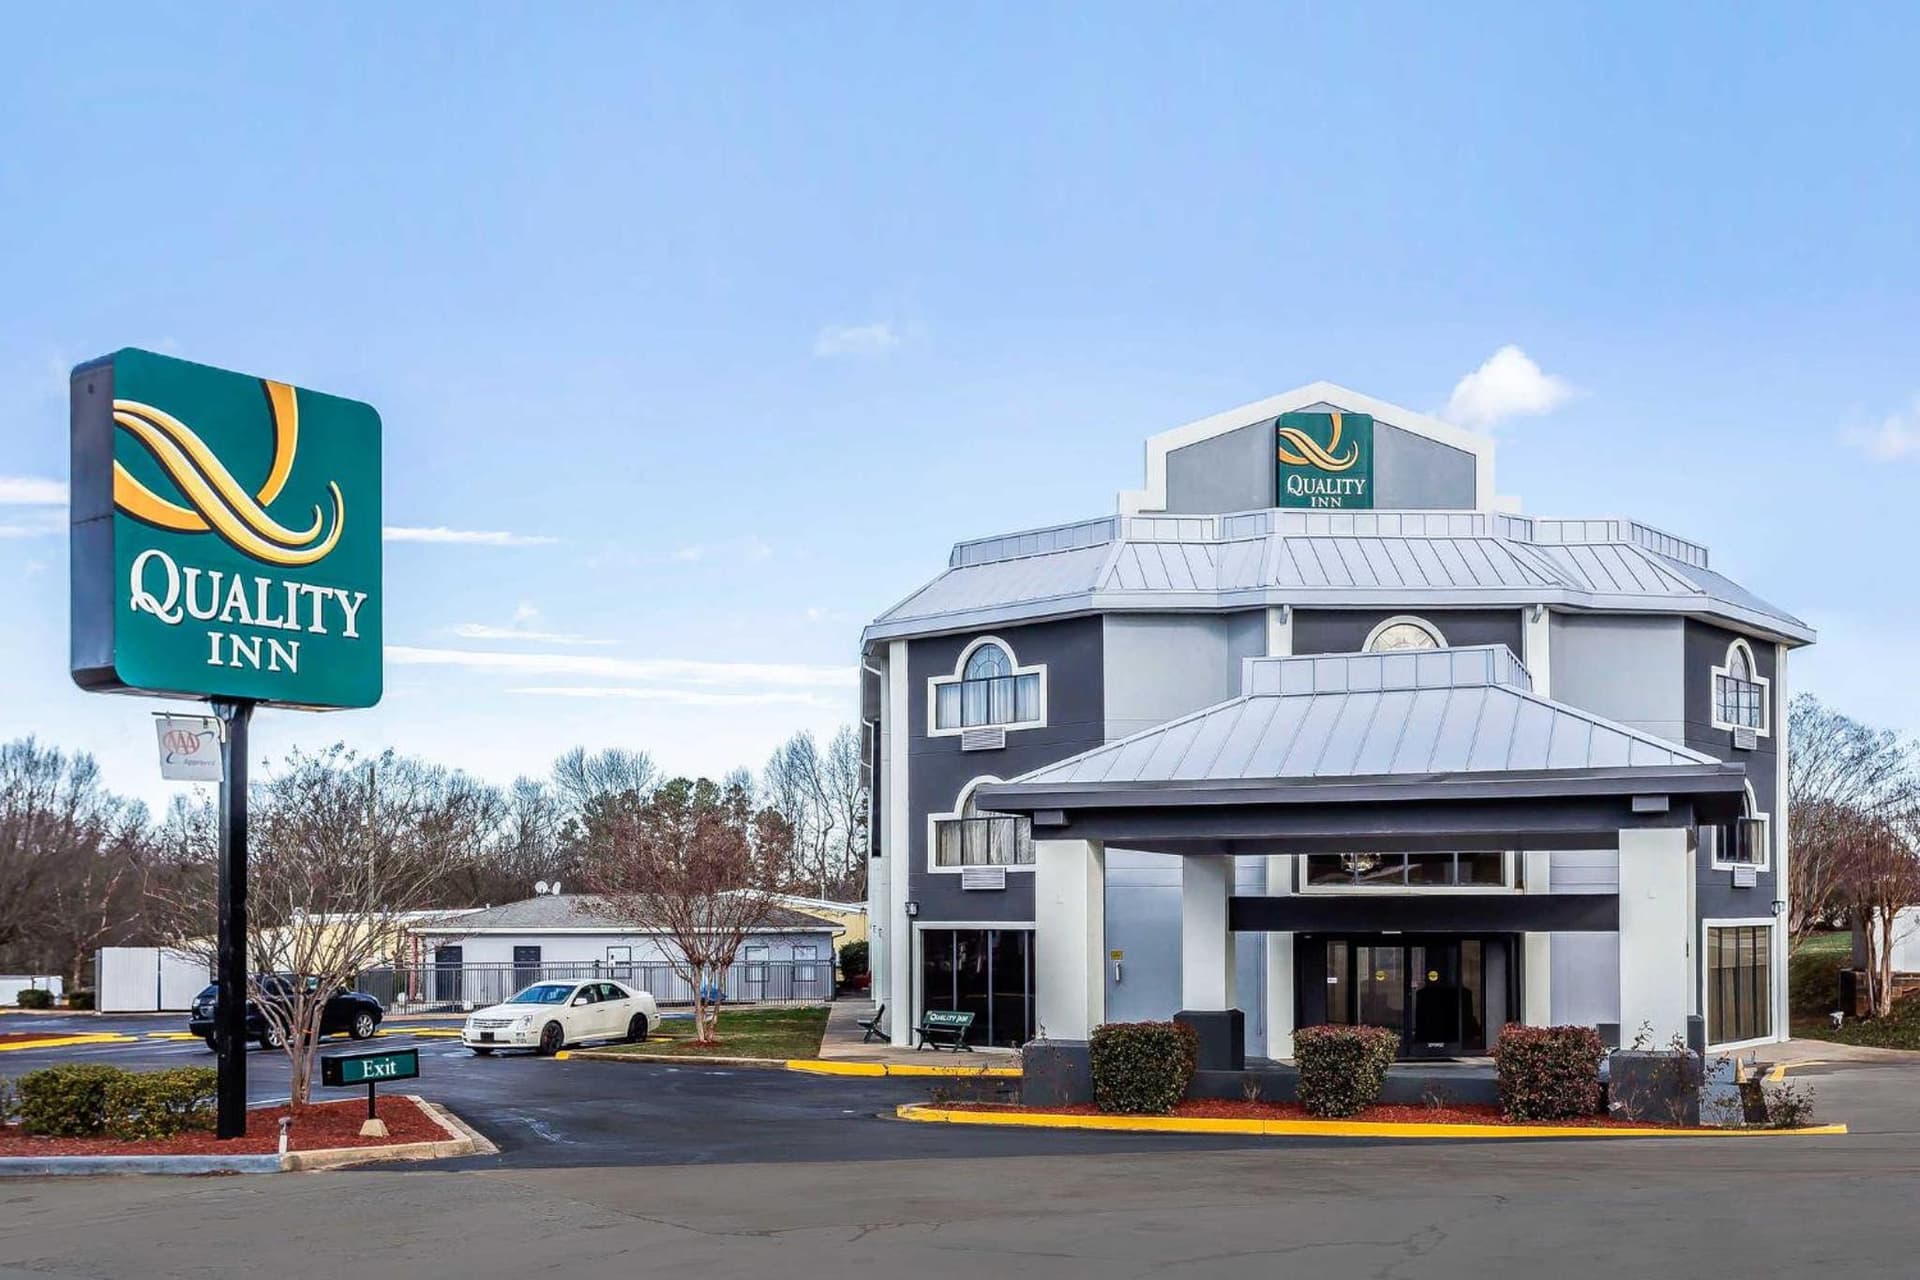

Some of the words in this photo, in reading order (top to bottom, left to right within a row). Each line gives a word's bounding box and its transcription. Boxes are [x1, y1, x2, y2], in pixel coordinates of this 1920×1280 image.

[1287, 474, 1366, 496] QUALITY
[1311, 496, 1342, 507] INN
[130, 549, 367, 638] QUALITY
[207, 631, 300, 673] INN
[165, 730, 199, 755] AAA
[362, 1058, 396, 1078] Exit
